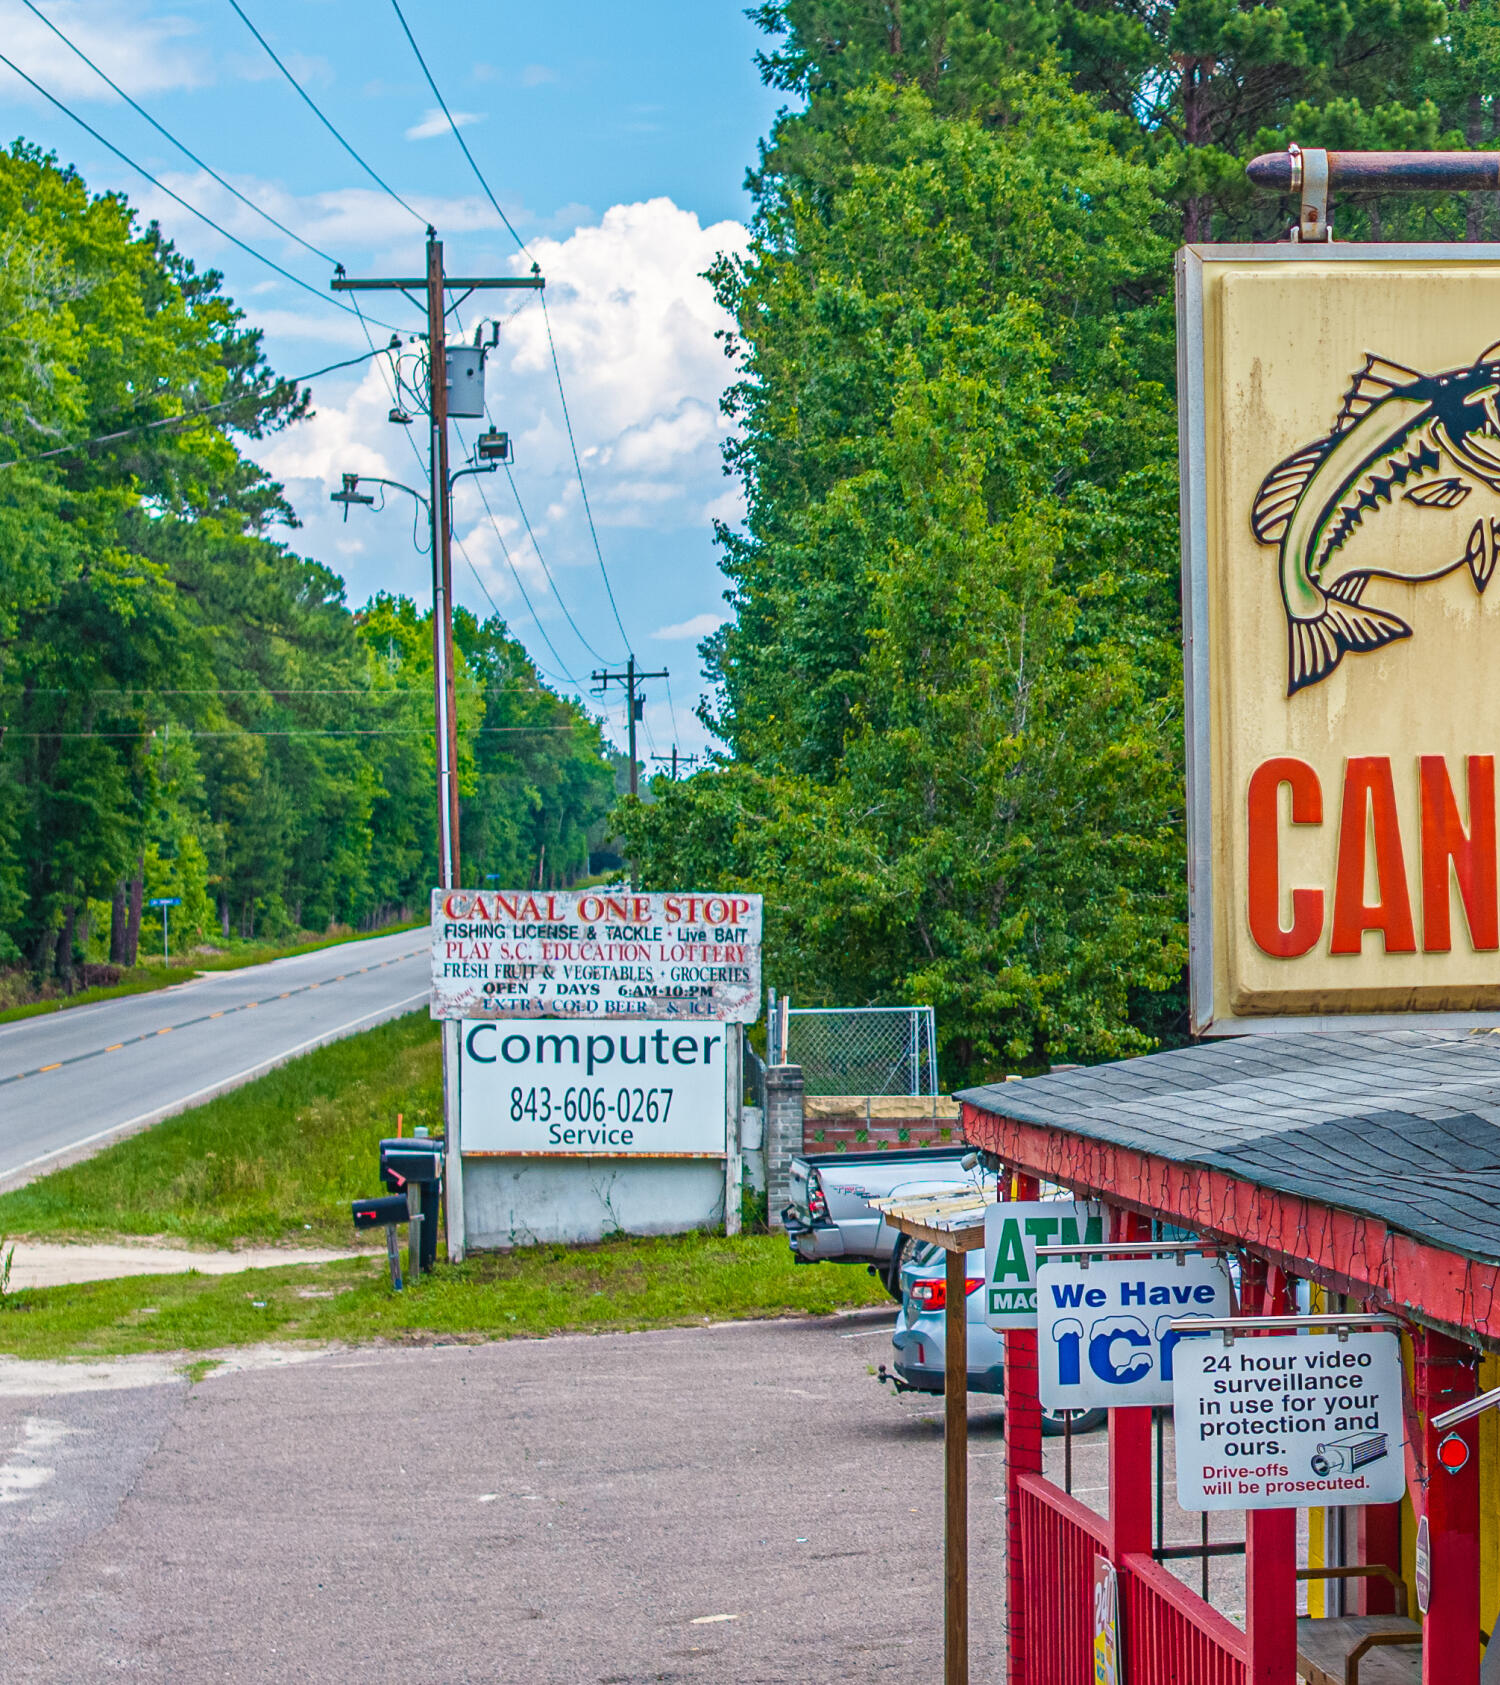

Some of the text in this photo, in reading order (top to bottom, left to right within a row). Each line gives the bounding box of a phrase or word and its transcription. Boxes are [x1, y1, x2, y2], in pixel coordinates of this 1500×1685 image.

[442, 894, 750, 925] CANAL ONE STOP
[444, 923, 748, 943] FISHING LICENSE & TACKLE Live BAIT
[446, 942, 747, 963] PLAY S.C. EDUCATION LOTTERY
[443, 963, 750, 983] FRESH FRUIT & VEGETABLES GROCERIES
[483, 982, 529, 994] OPEN
[538, 983, 547, 994] 7
[556, 983, 600, 995] DAYS
[484, 998, 545, 1011] EXTRA
[605, 1000, 648, 1014] BEER
[465, 1023, 721, 1077] Computer
[510, 1086, 674, 1123] 843-606-0267
[549, 1123, 634, 1145] Service
[992, 1216, 1103, 1283] ATM
[1051, 1281, 1216, 1309] We Have
[1202, 1350, 1372, 1373] 24 hour video
[1213, 1373, 1363, 1394] surveillance
[1199, 1393, 1379, 1415] in use for your
[1199, 1412, 1379, 1441] protection and
[1224, 1440, 1287, 1456] ours.
[1202, 1463, 1289, 1479] Drive-offs
[1202, 1476, 1370, 1496] will be prosecuted.
